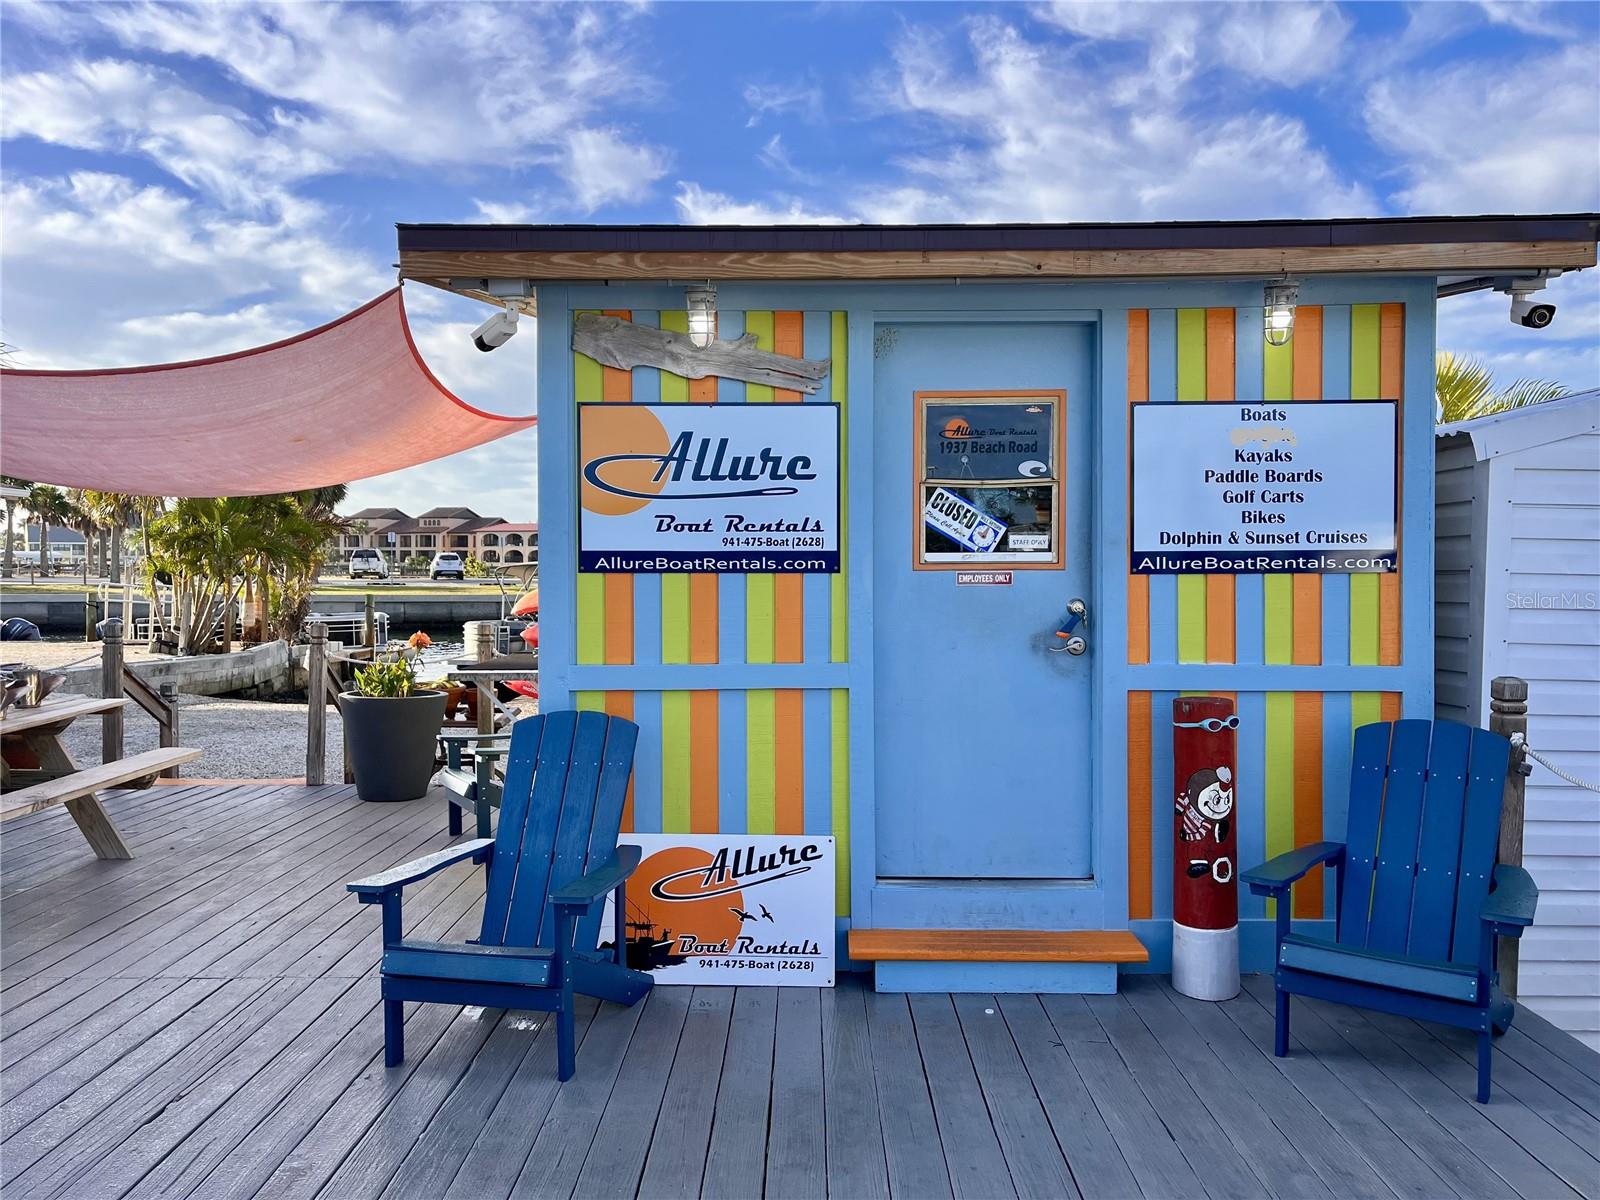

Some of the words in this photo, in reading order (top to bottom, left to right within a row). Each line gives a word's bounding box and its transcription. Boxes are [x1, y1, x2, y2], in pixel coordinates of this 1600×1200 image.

[1241, 408, 1287, 421] Boats
[950, 425, 987, 437] Allure
[940, 441, 968, 454] 1937
[971, 441, 1006, 453] Beach
[1008, 441, 1038, 453] Road
[651, 431, 817, 482] Allure
[1234, 449, 1293, 465] Kayaks
[1204, 469, 1259, 483] Paddle
[1265, 469, 1323, 483] Boards
[1223, 490, 1256, 504] Golf
[1261, 489, 1304, 503] Carts
[931, 492, 979, 530] CLOSED
[1241, 510, 1286, 524] Bikes
[654, 514, 714, 532] Boat
[723, 514, 825, 532] Rentals
[722, 537, 789, 547] 941-475-Boat
[792, 537, 824, 548] (2628)
[1159, 531, 1222, 547] Dolphin
[1228, 531, 1240, 544] &
[1245, 530, 1300, 544] Sunset
[1306, 530, 1368, 544] Cruises
[594, 556, 826, 570] AllureBoatRentals.com
[1138, 556, 1391, 570] AllureBoatRentals.com
[958, 574, 993, 583] EMPLOYEES
[994, 574, 1010, 583] ONLY
[700, 843, 823, 888] Allure
[678, 935, 730, 955] Boat
[737, 936, 822, 955] Rentals
[699, 959, 775, 970] 941-475-Boat
[777, 960, 814, 972] (2628)
